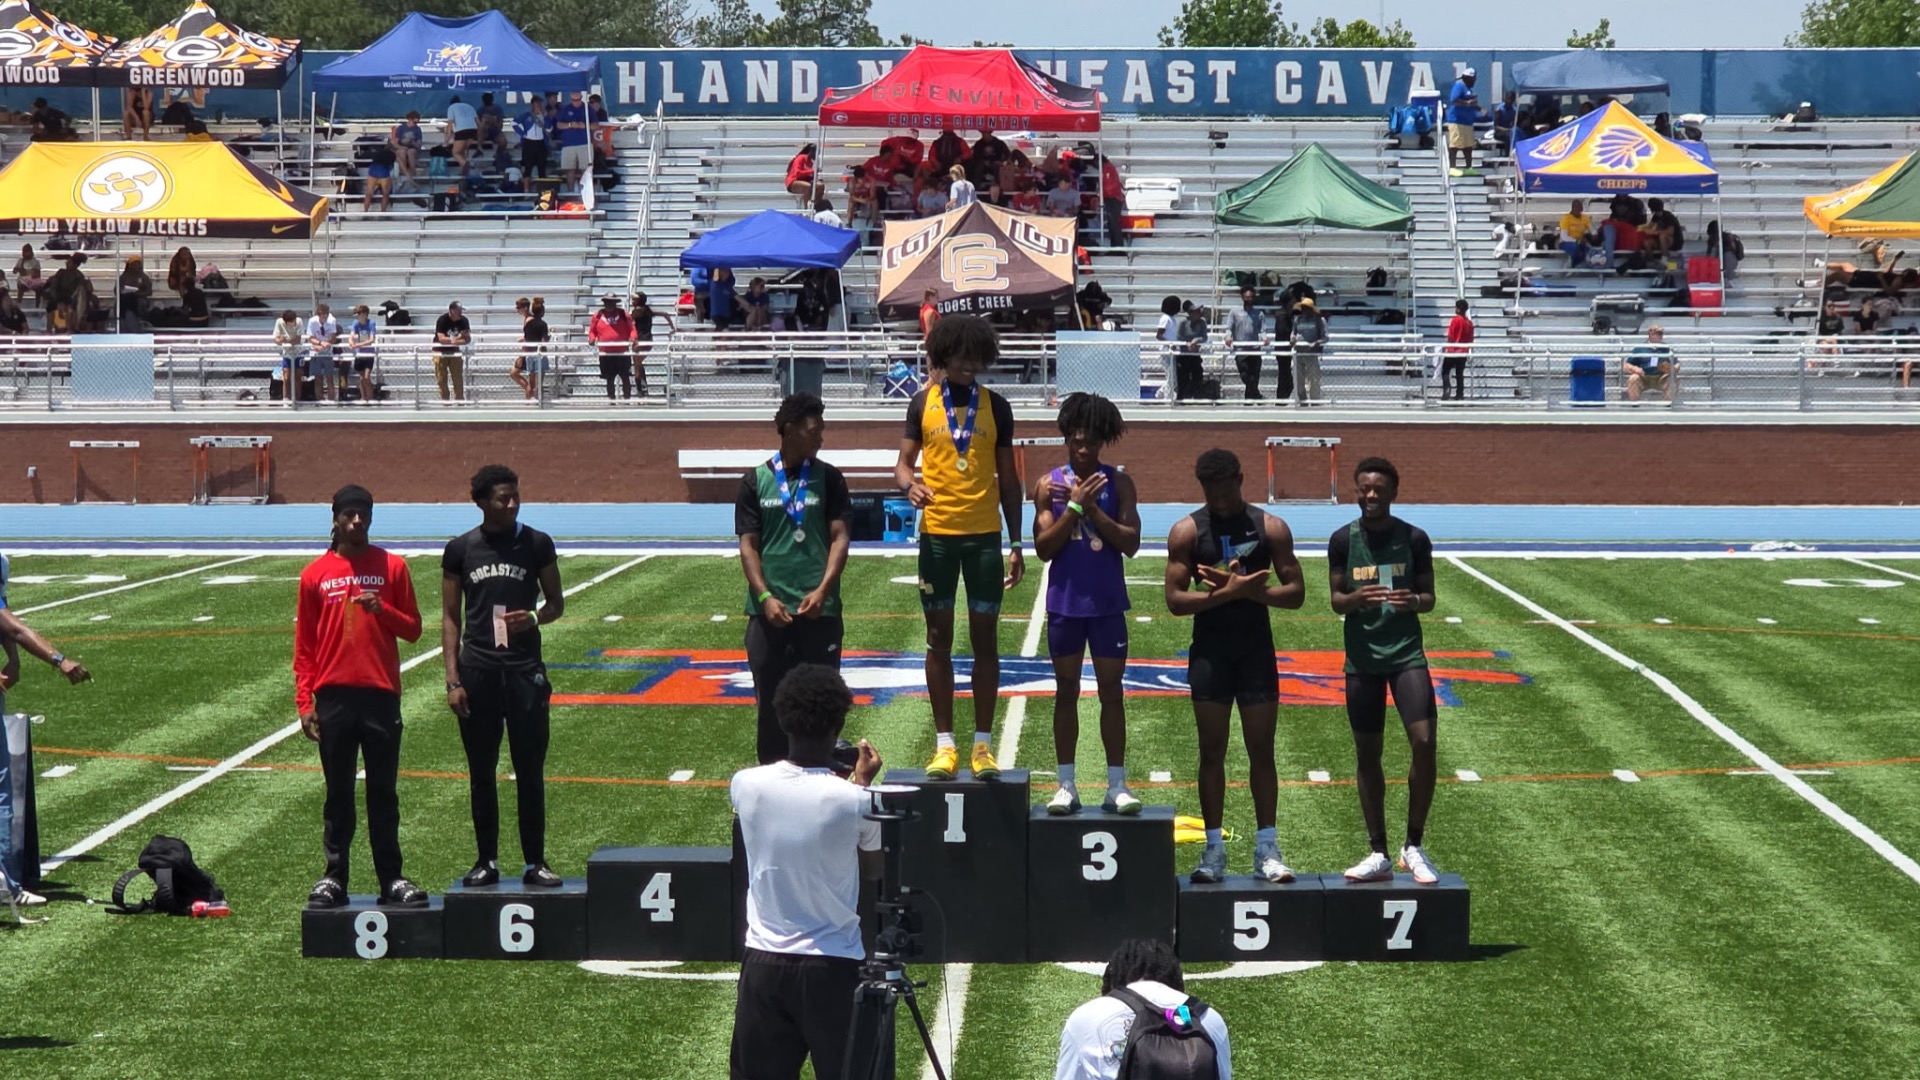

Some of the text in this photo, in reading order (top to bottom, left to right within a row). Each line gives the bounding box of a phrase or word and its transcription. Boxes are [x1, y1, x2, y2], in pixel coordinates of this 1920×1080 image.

[0, 66, 60, 84] WOOD
[130, 67, 245, 86] GREENWOOD
[506, 60, 819, 103] HLAND
[873, 81, 1047, 111] GREENVILLE
[888, 114, 1030, 129] CROSS COUNTRY
[1597, 178, 1648, 190] CHIEFS
[65, 218, 131, 233] YELLOW
[138, 219, 207, 235] JACKETS
[937, 295, 1013, 314] GOOSE CREEK
[321, 575, 385, 591] WESTWOOD
[470, 563, 527, 584] SOCASTEE
[1352, 563, 1406, 580] CONAY
[944, 793, 966, 842] 1
[1082, 831, 1118, 881] 3
[640, 872, 675, 922] 4
[354, 911, 388, 959] 8
[500, 903, 534, 952] 6
[1233, 901, 1270, 951] 5
[1383, 900, 1418, 949] 7
